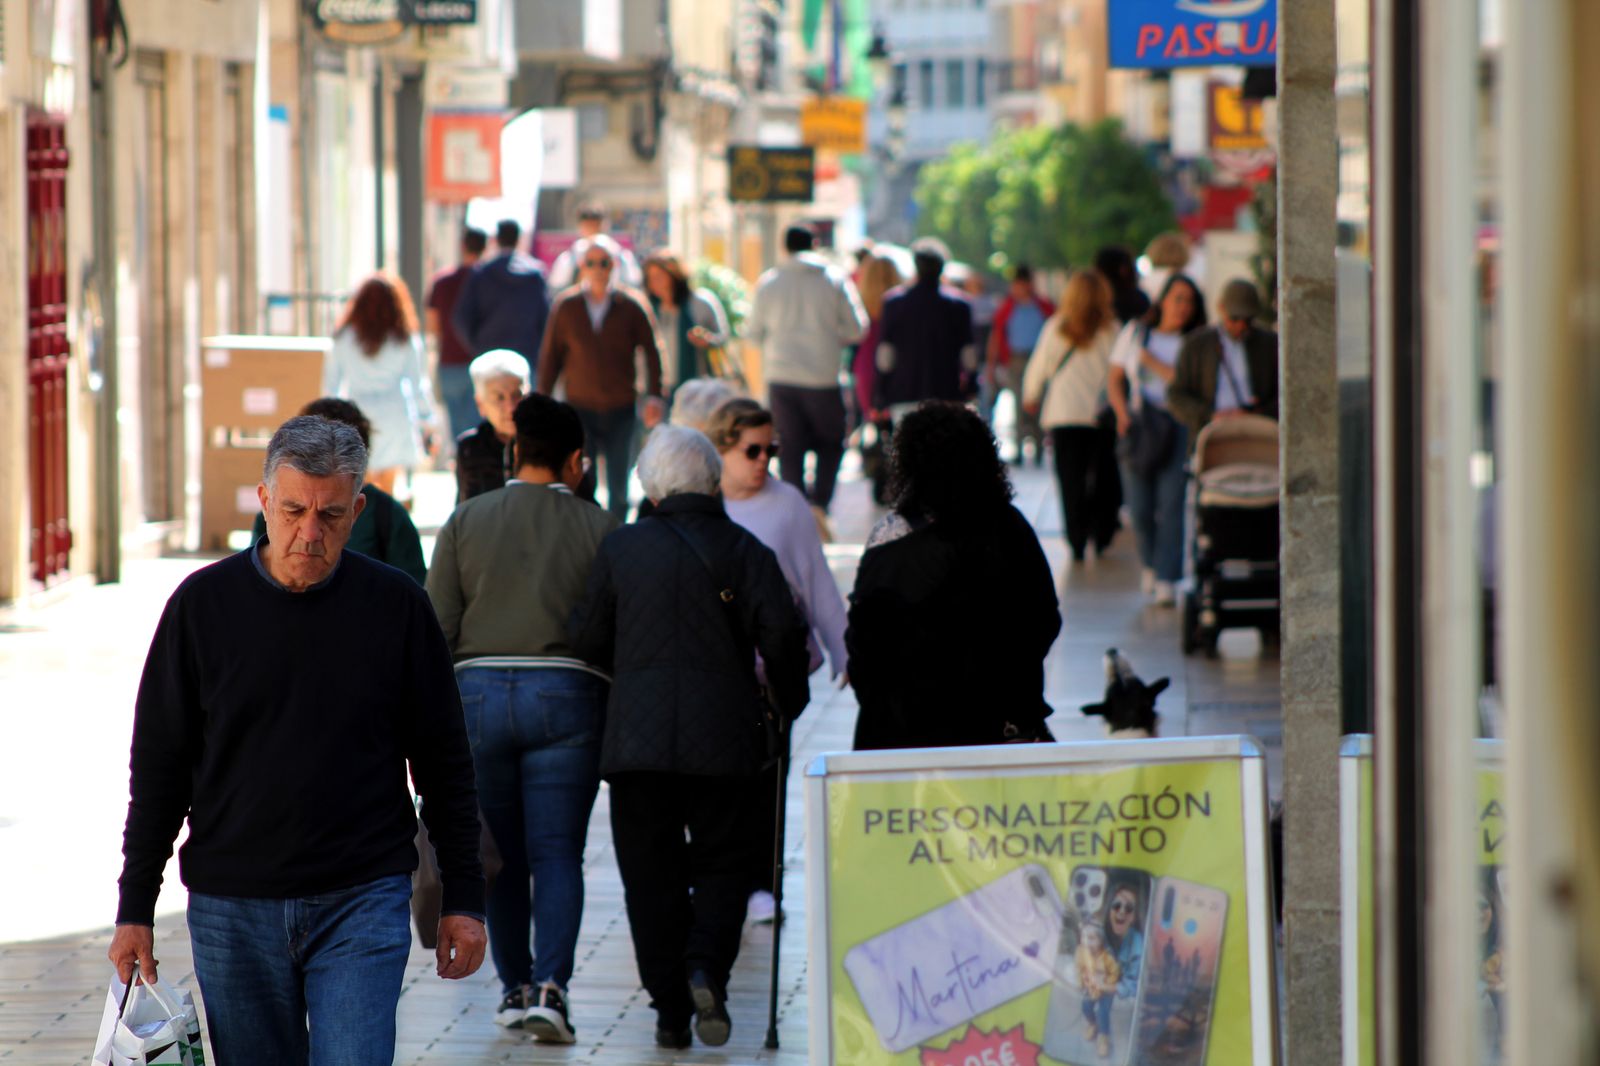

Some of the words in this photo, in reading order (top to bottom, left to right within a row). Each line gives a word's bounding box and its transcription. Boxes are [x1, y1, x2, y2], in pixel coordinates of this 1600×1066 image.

[863, 785, 1211, 835] PERSONALIZACIÓN
[908, 838, 954, 865] AL
[967, 825, 1167, 862] MOMENTO
[886, 949, 1021, 1042] Martina
